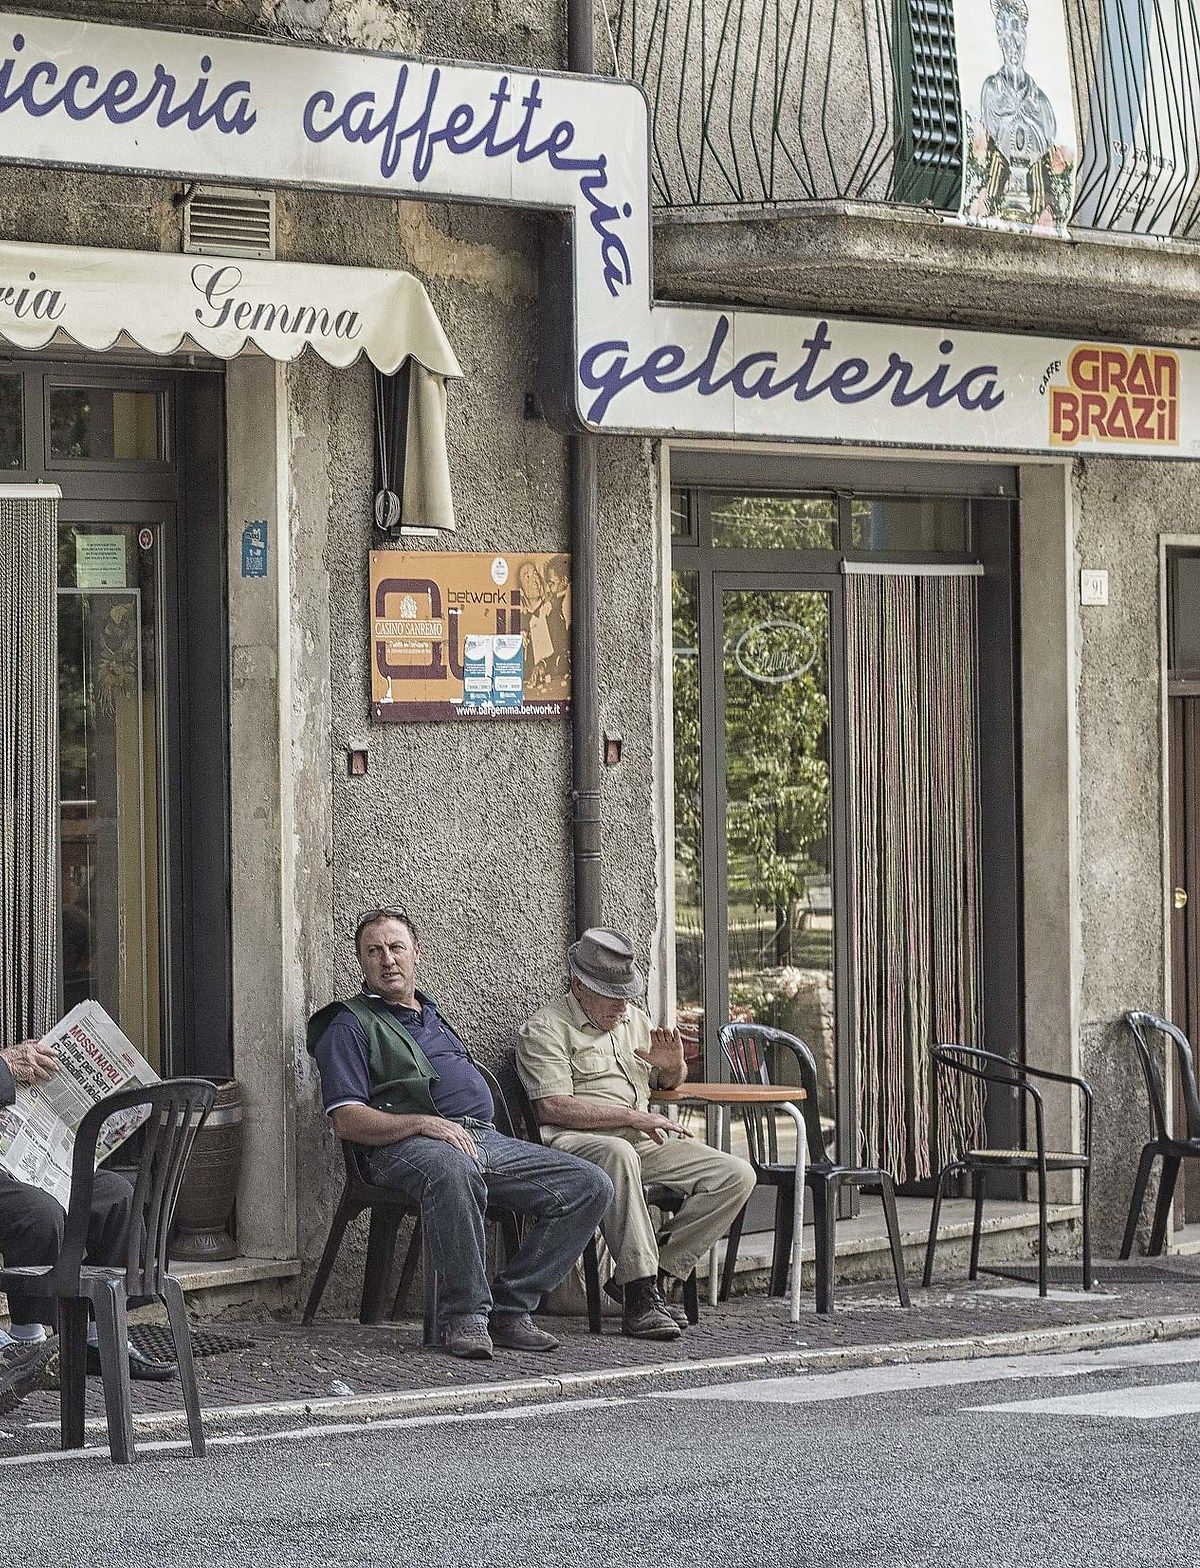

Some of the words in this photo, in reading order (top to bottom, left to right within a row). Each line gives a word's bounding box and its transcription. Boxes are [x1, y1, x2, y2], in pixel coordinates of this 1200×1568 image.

[303, 64, 632, 298] caffetteria
[191, 263, 363, 340] Gemma
[579, 314, 1006, 425] gelateria
[447, 588, 507, 604] betwork
[1092, 579, 1103, 596] 91
[405, 622, 443, 637] SANREMO
[455, 702, 561, 718] www.bargemma.betwork.it
[59, 1033, 86, 1062] Kalinic
[80, 1061, 96, 1077] per
[69, 1024, 100, 1058] MOSSA
[93, 1052, 123, 1085] NAPOLI
[83, 1081, 102, 1103] viola
